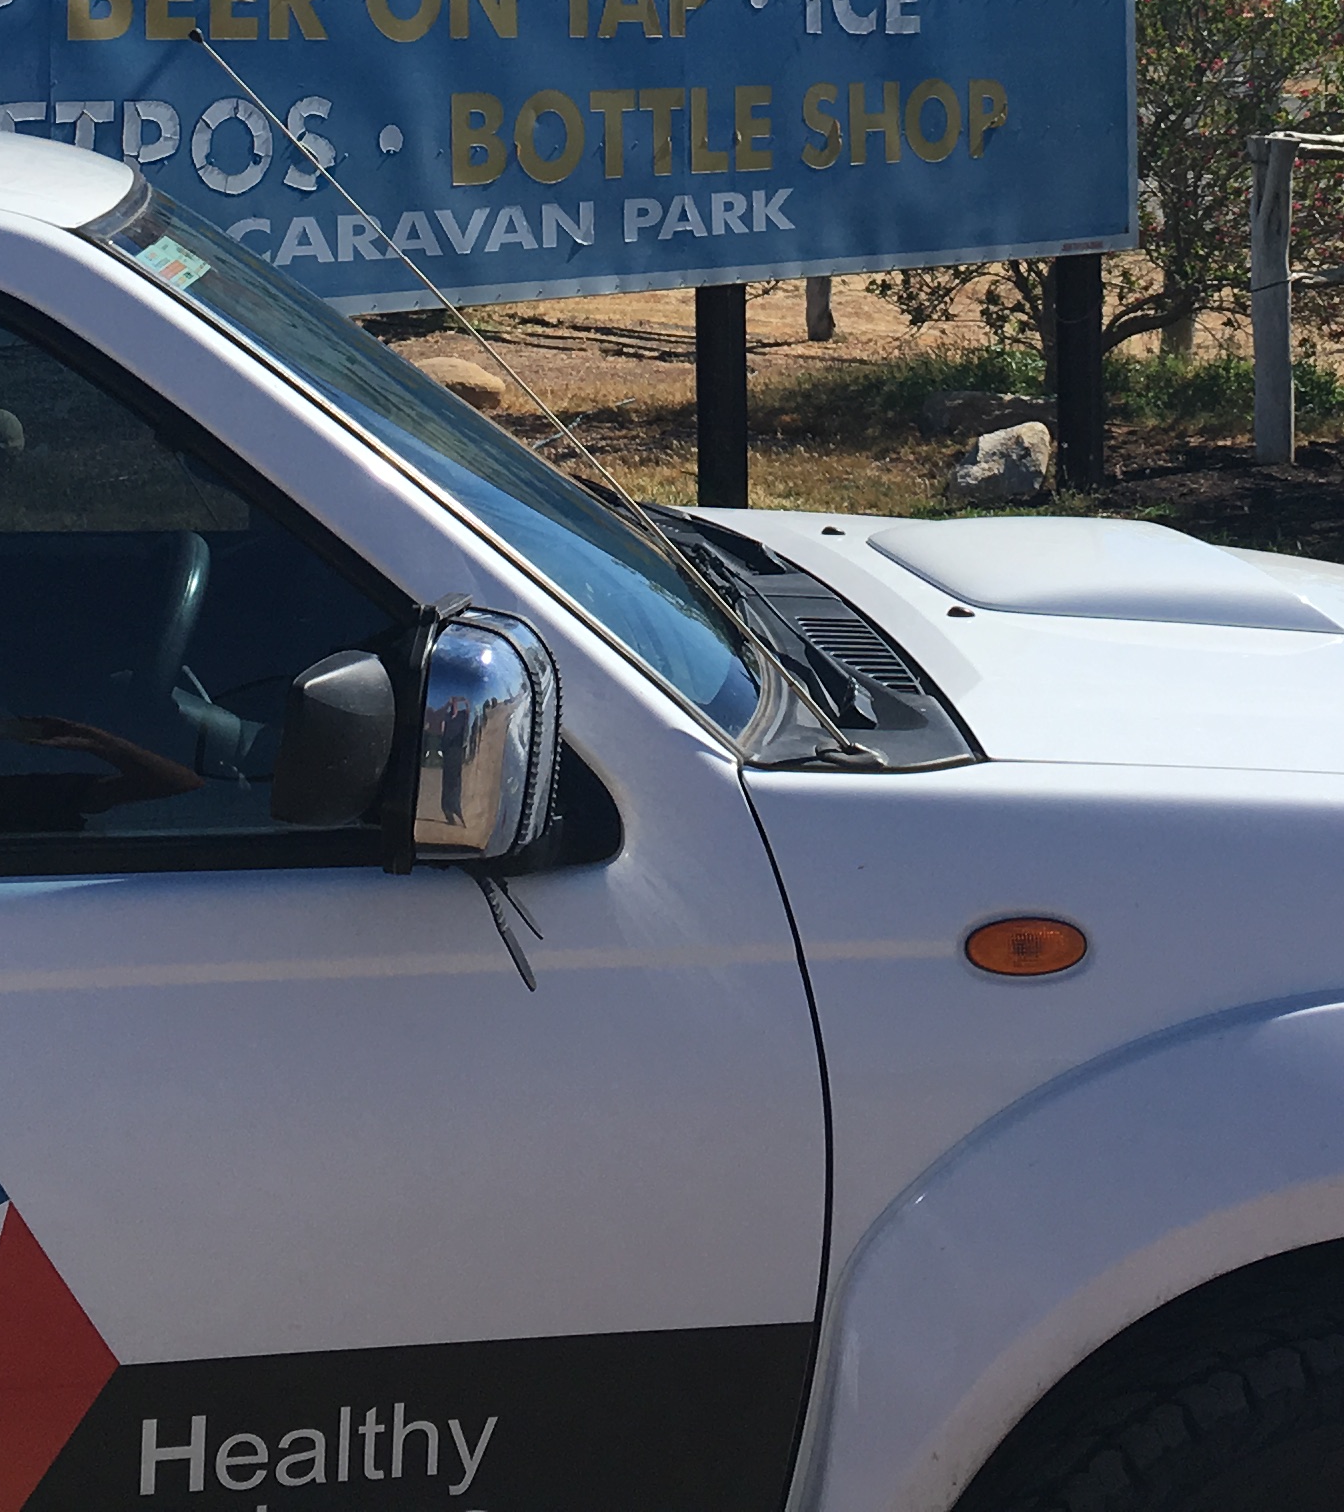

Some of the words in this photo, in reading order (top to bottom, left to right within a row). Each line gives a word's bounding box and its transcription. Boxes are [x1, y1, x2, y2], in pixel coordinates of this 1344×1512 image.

[451, 85, 773, 186] BOTTLE
[801, 78, 1008, 170] SHOP
[224, 199, 595, 266] CARAVAN
[623, 187, 796, 243] PARK
[139, 1402, 499, 1496] Healthy
